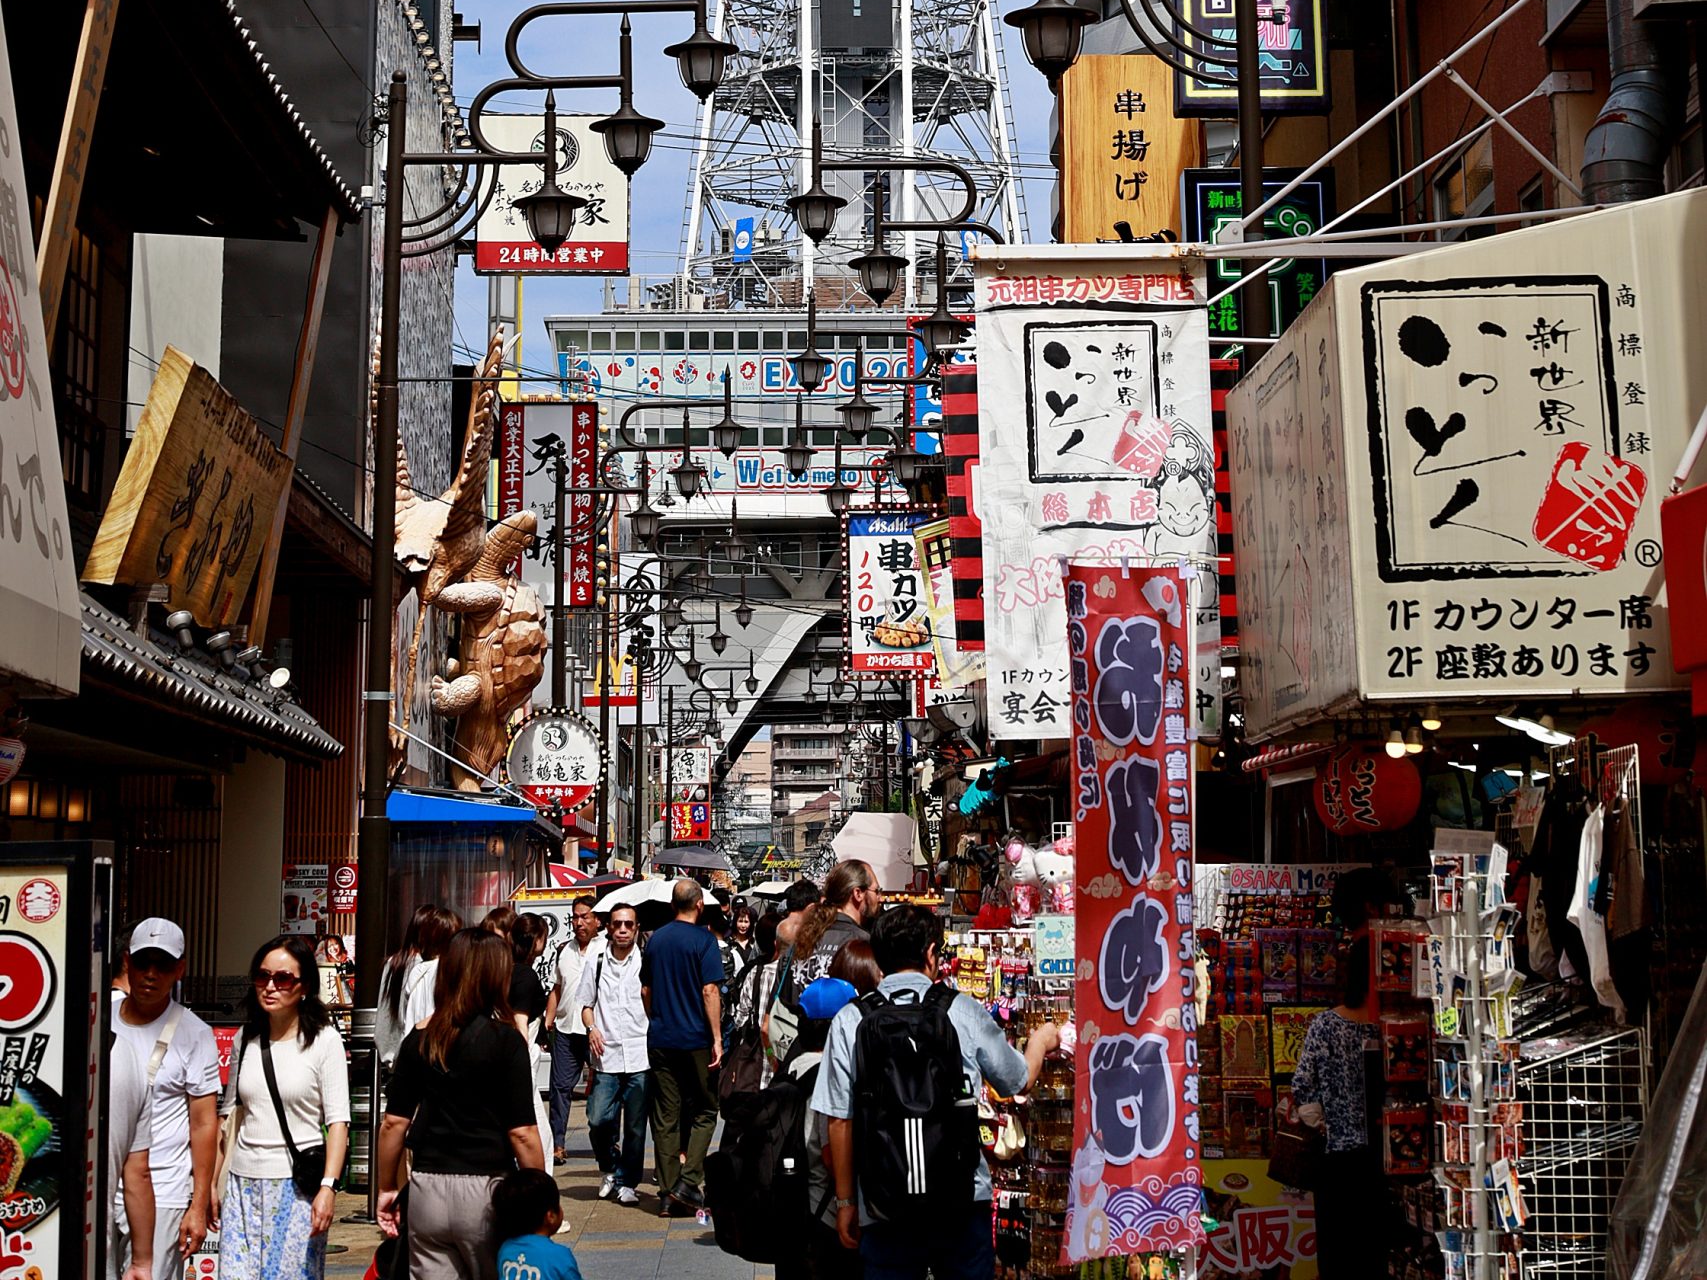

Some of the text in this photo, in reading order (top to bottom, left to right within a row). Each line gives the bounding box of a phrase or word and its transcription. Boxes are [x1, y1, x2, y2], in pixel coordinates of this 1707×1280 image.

[1111, 88, 1151, 201] 串揚げ
[987, 274, 1195, 302] 元祖串カツ専門店
[1111, 342, 1143, 407] 新世界
[1525, 317, 1585, 436] 新世界
[1614, 283, 1651, 454] 商標登録
[877, 538, 918, 623] 串カツ
[1387, 595, 1654, 631] 1F カウンター席
[1386, 643, 1656, 680] 2F 座敷あります
[999, 688, 1071, 725] 宴会
[534, 787, 575, 797] 年中無休
[1230, 867, 1293, 891] OSAKA
